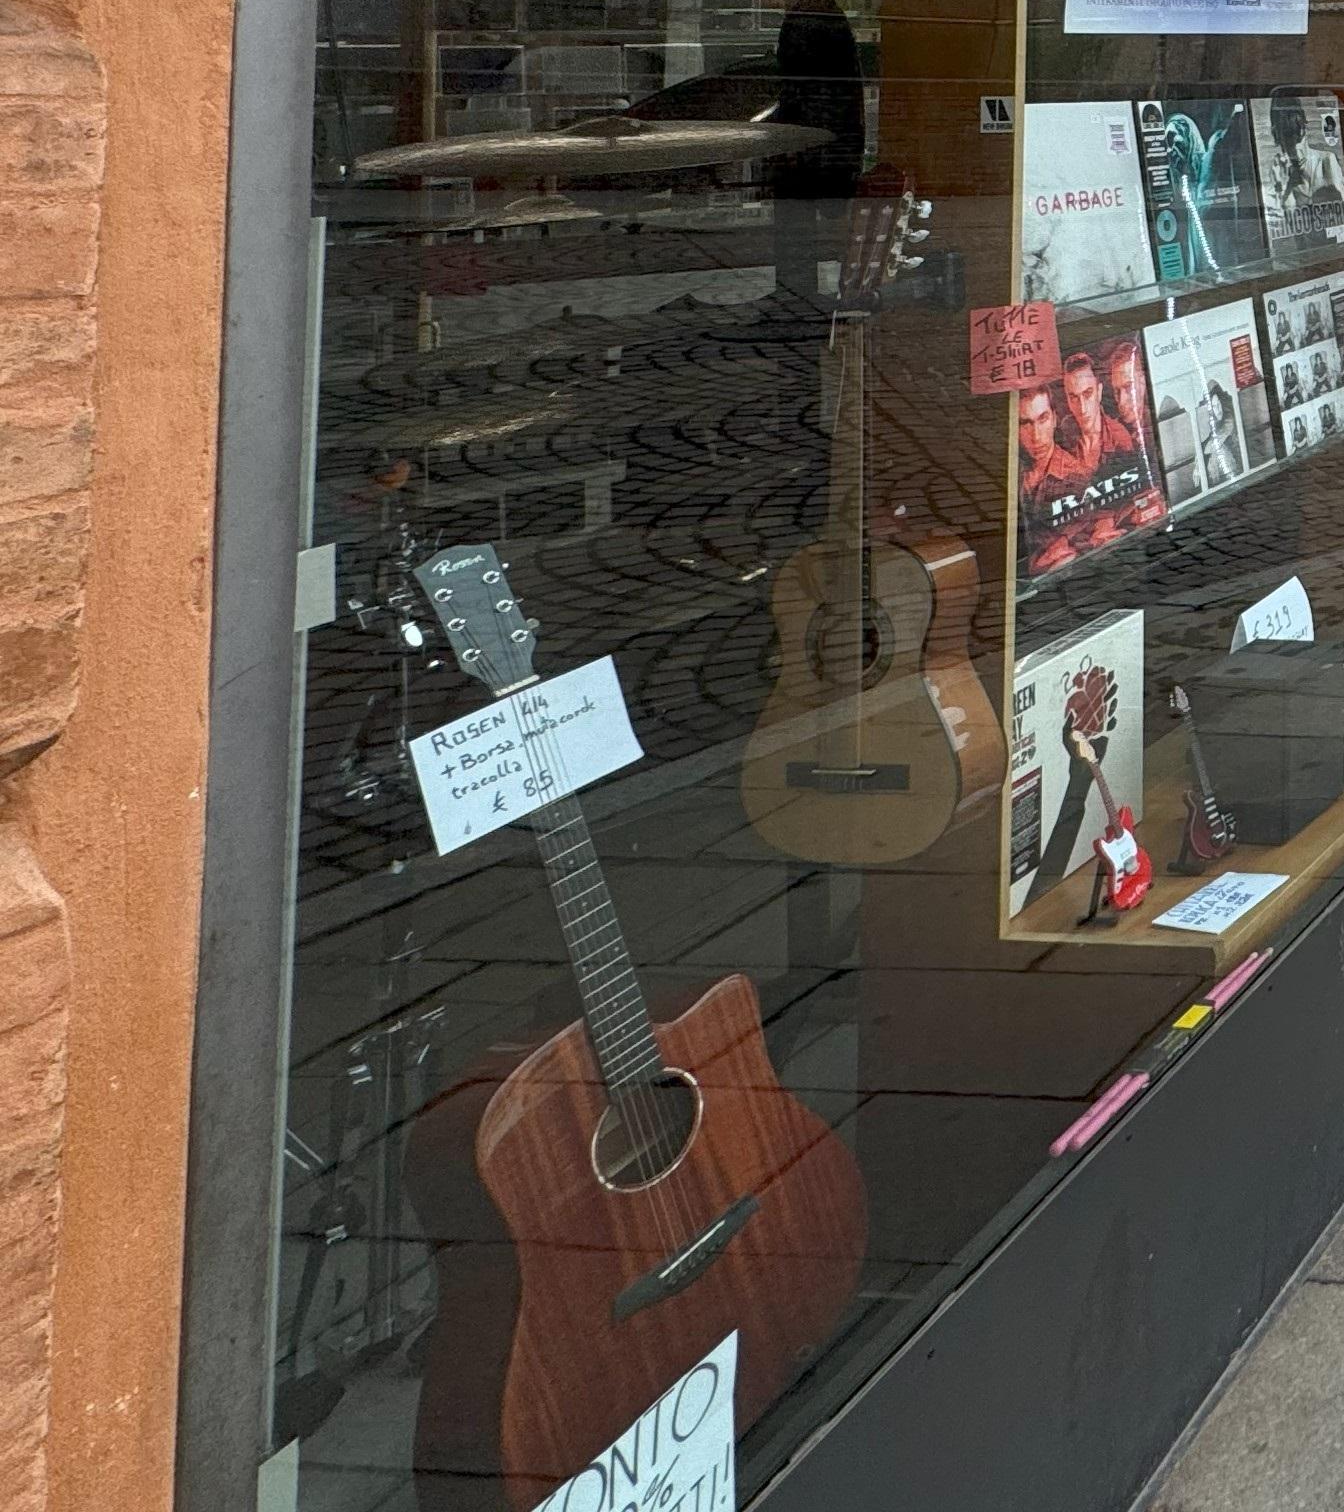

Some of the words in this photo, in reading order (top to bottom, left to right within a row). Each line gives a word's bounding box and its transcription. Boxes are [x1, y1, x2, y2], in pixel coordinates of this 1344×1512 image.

[1036, 187, 1125, 216] GARBAGE
[975, 304, 1040, 334] TUTTE
[1001, 331, 1023, 345] LE
[1012, 359, 1036, 380] 18
[1051, 467, 1139, 516] RATS
[1266, 605, 1292, 639] 319
[431, 712, 506, 756] ROSEN
[452, 759, 523, 799] tracolla
[523, 769, 554, 797] 85
[543, 1362, 719, 1512] ONTO
